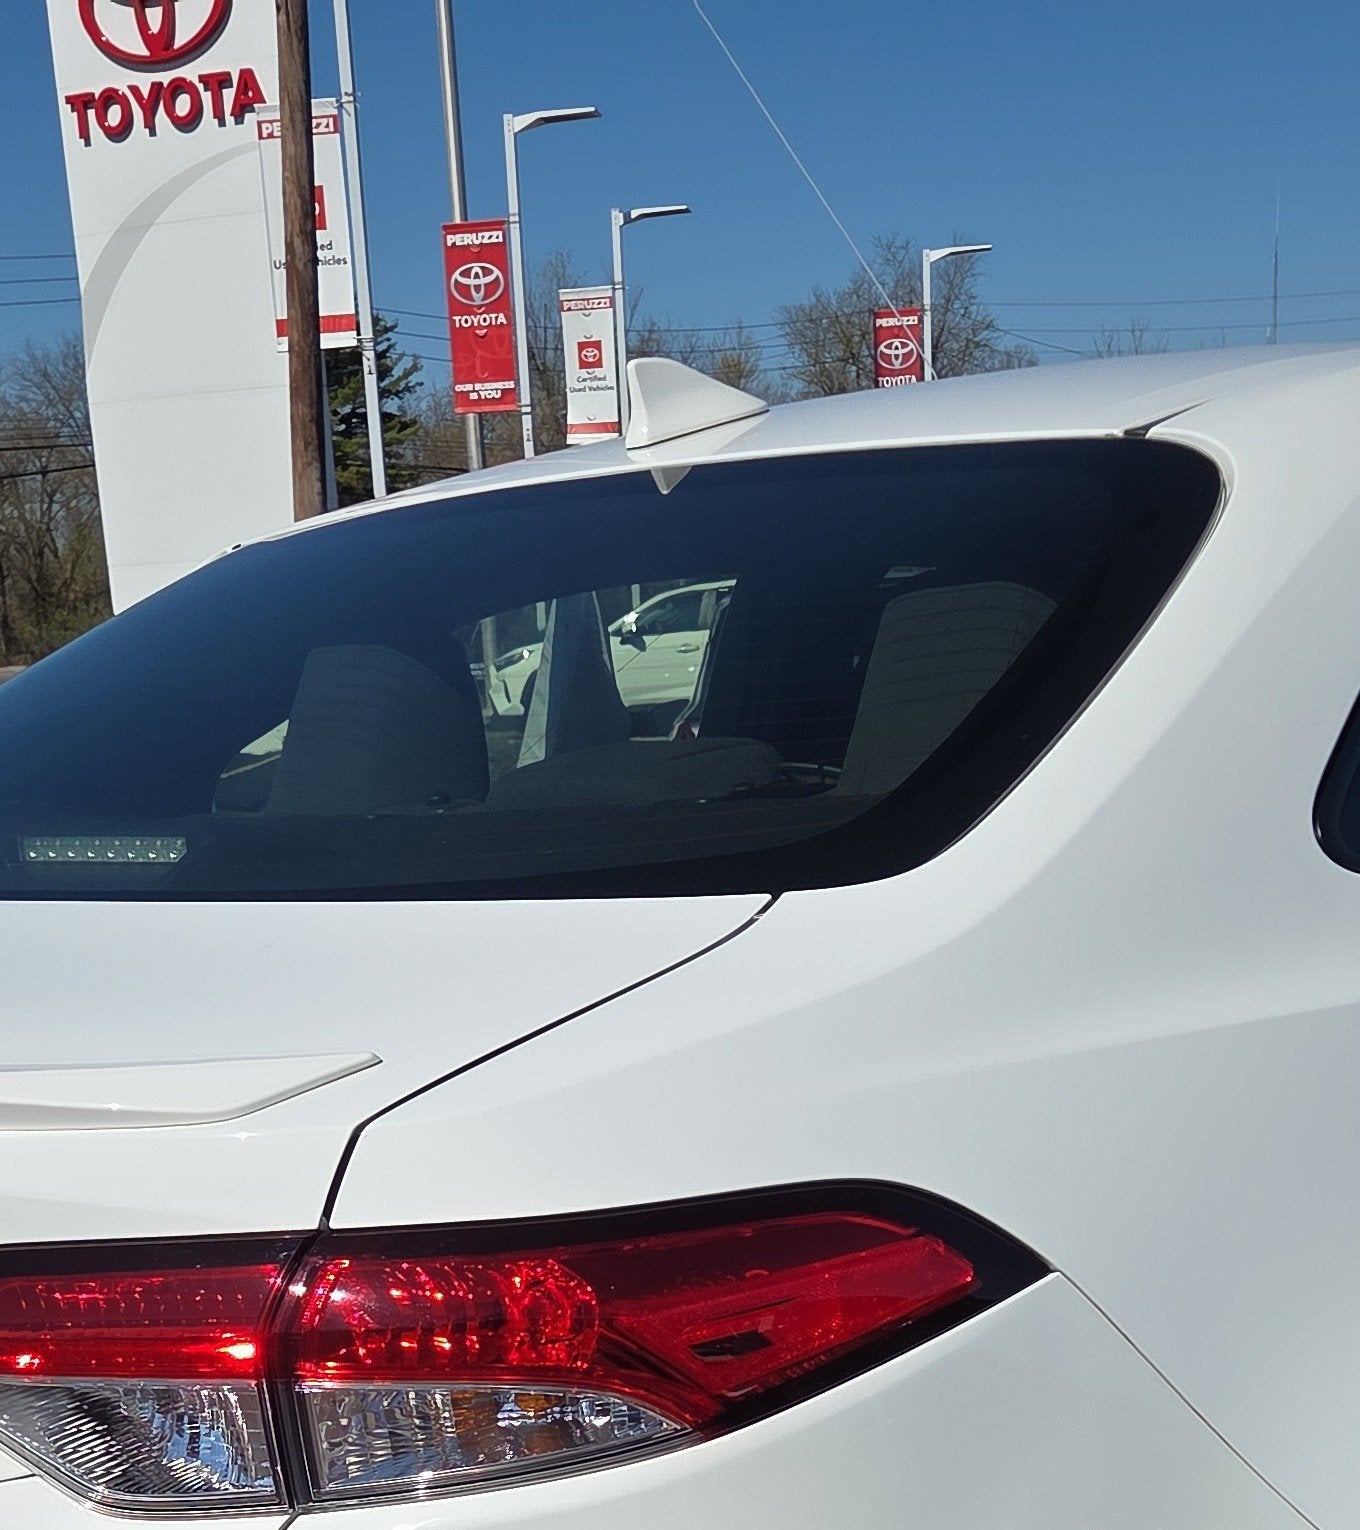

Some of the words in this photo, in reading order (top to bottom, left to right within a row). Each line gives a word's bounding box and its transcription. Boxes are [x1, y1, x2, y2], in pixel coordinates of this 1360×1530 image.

[65, 68, 267, 144] TOYOTA
[261, 117, 335, 138] PEZZI
[446, 231, 503, 247] PERUZZI
[562, 297, 611, 311] PERUZZI
[452, 313, 507, 328] TOYOTA
[877, 375, 917, 388] TOYOTA
[479, 389, 502, 400] YOU
